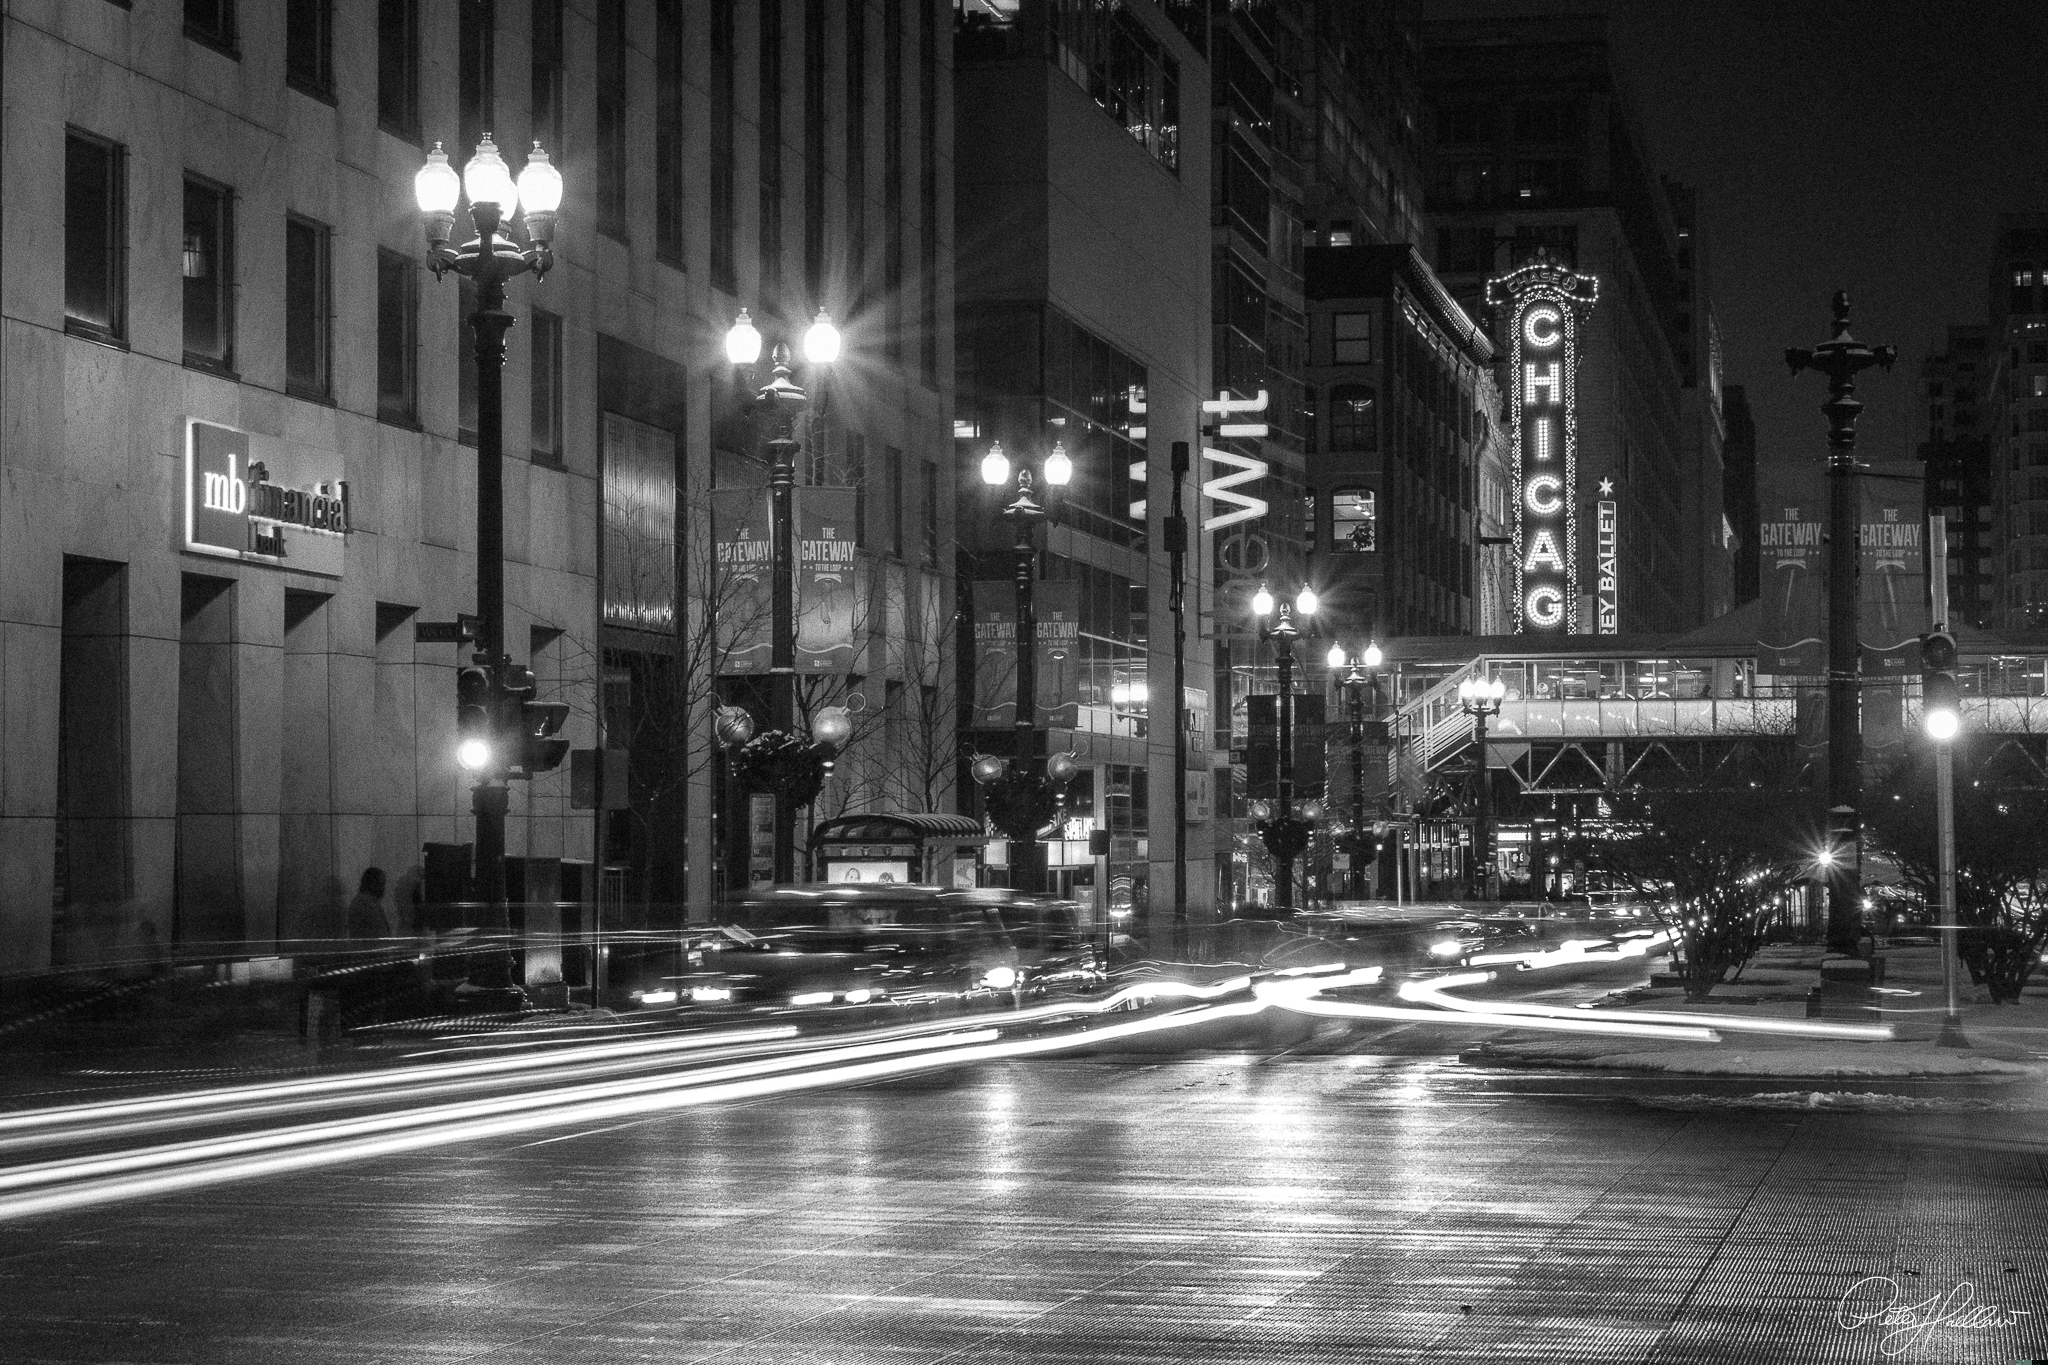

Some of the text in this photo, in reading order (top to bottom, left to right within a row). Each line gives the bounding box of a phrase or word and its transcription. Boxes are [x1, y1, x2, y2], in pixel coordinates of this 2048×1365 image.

[1507, 272, 1561, 292] CHASE
[204, 453, 246, 514] mb
[250, 461, 352, 534] financial
[1784, 508, 1799, 520] THE
[1883, 509, 1898, 521] THE
[822, 527, 835, 539] THE
[1760, 523, 1822, 545] GATEWAY
[1860, 524, 1920, 546] GATEWAY
[717, 541, 769, 562] GATEWAY
[801, 540, 855, 561] GATEWAY
[1600, 504, 1615, 591] BALLET
[990, 612, 1000, 621] THE
[1053, 611, 1063, 620] THE
[975, 622, 1017, 638] GATEWAY
[1036, 622, 1079, 638] GATEWAY
